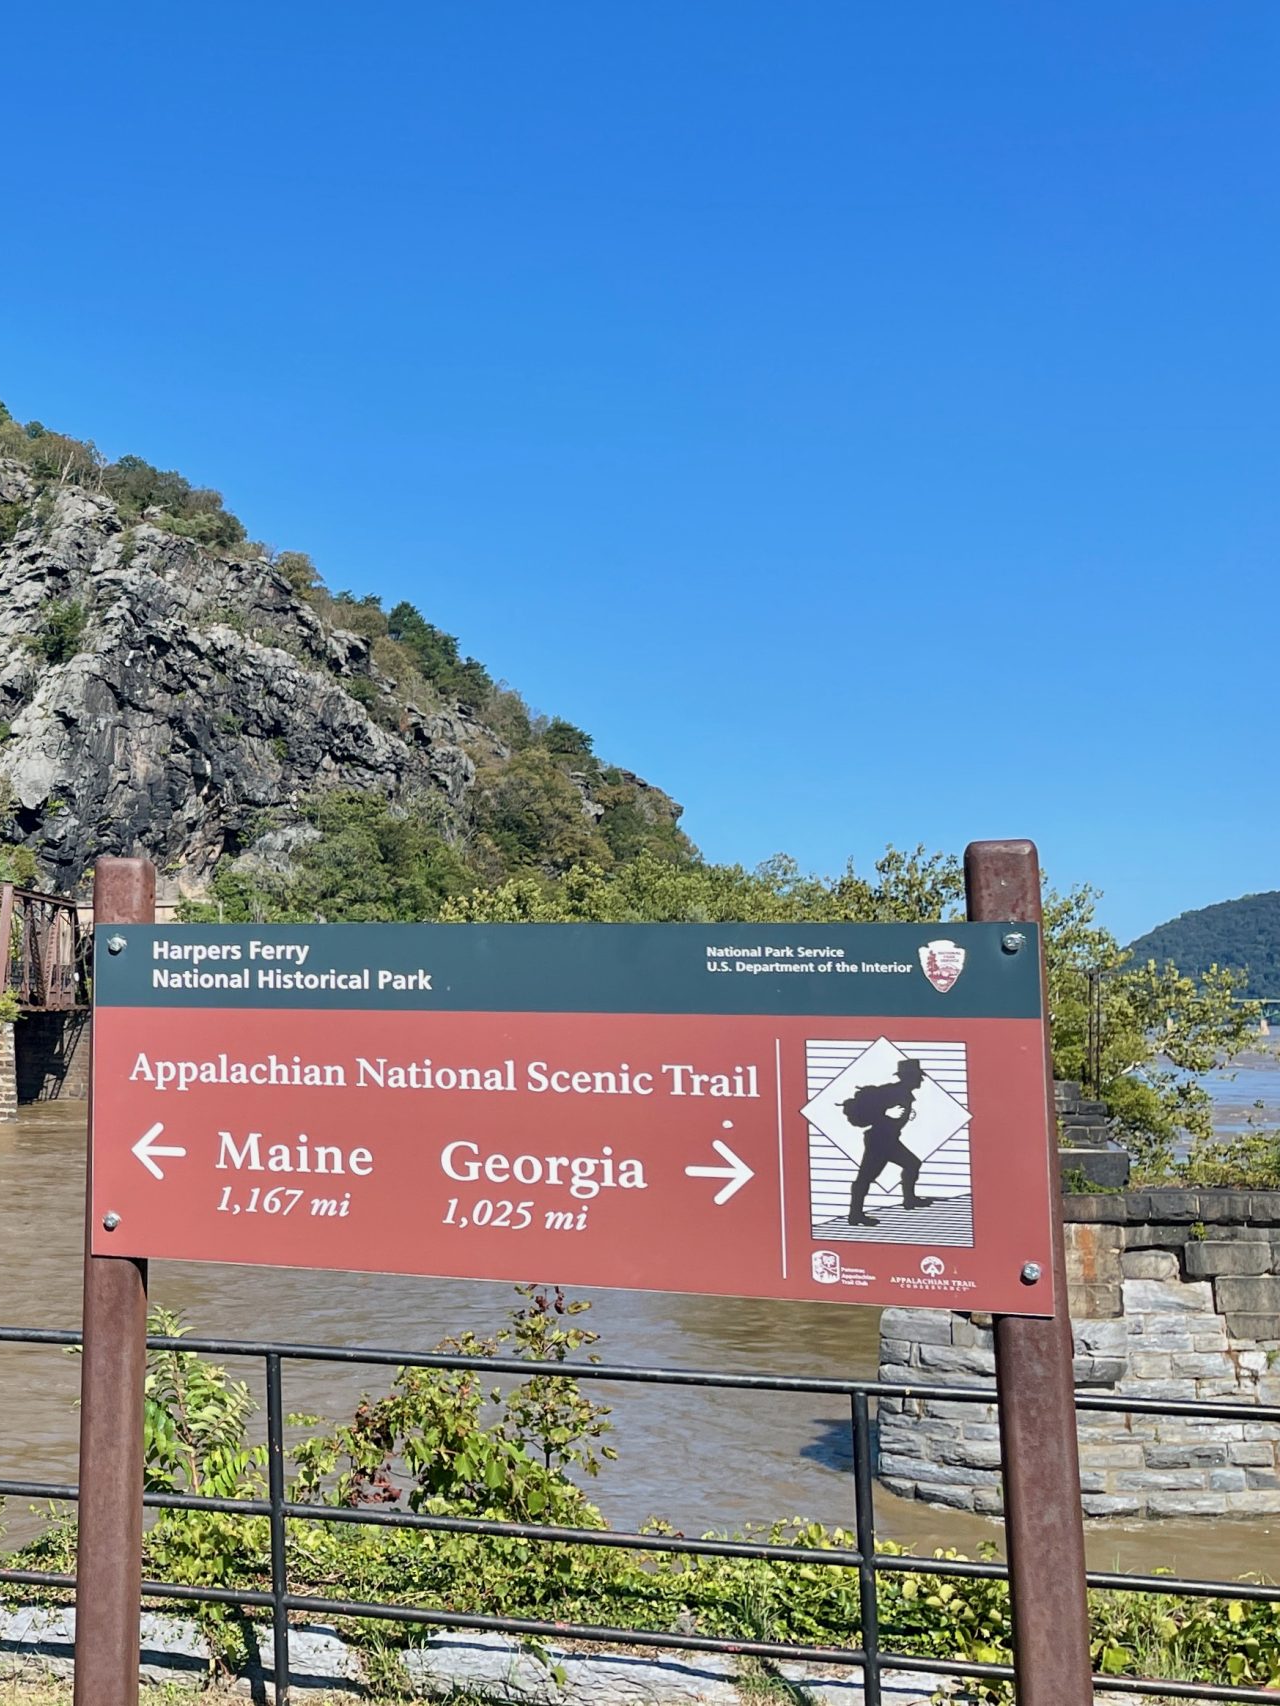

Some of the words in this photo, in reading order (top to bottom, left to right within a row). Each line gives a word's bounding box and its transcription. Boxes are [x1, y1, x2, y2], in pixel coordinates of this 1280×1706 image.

[153, 941, 241, 964] Harpers
[250, 941, 309, 964] Ferry
[706, 946, 761, 958] National
[765, 946, 793, 958] Park
[798, 946, 844, 958] Service
[153, 969, 249, 989] National
[258, 969, 369, 990] Historical
[379, 970, 433, 990] Park
[706, 961, 733, 972] U.S.
[736, 961, 814, 975] Department
[818, 961, 832, 972] of
[835, 961, 859, 973] the
[862, 961, 913, 973] Interior
[129, 1053, 347, 1091] Appalachian
[356, 1057, 517, 1090] National
[527, 1062, 654, 1095] Scenic
[661, 1065, 761, 1098] Trail
[215, 1132, 373, 1176] Maine
[441, 1141, 649, 1200] Georgia
[217, 1186, 305, 1216] 1,167
[310, 1192, 351, 1218] mi
[442, 1197, 535, 1230] 1,025
[544, 1204, 589, 1231] mi
[889, 1276, 950, 1286] APPALACHIAN
[951, 1280, 977, 1288] TRAIL
